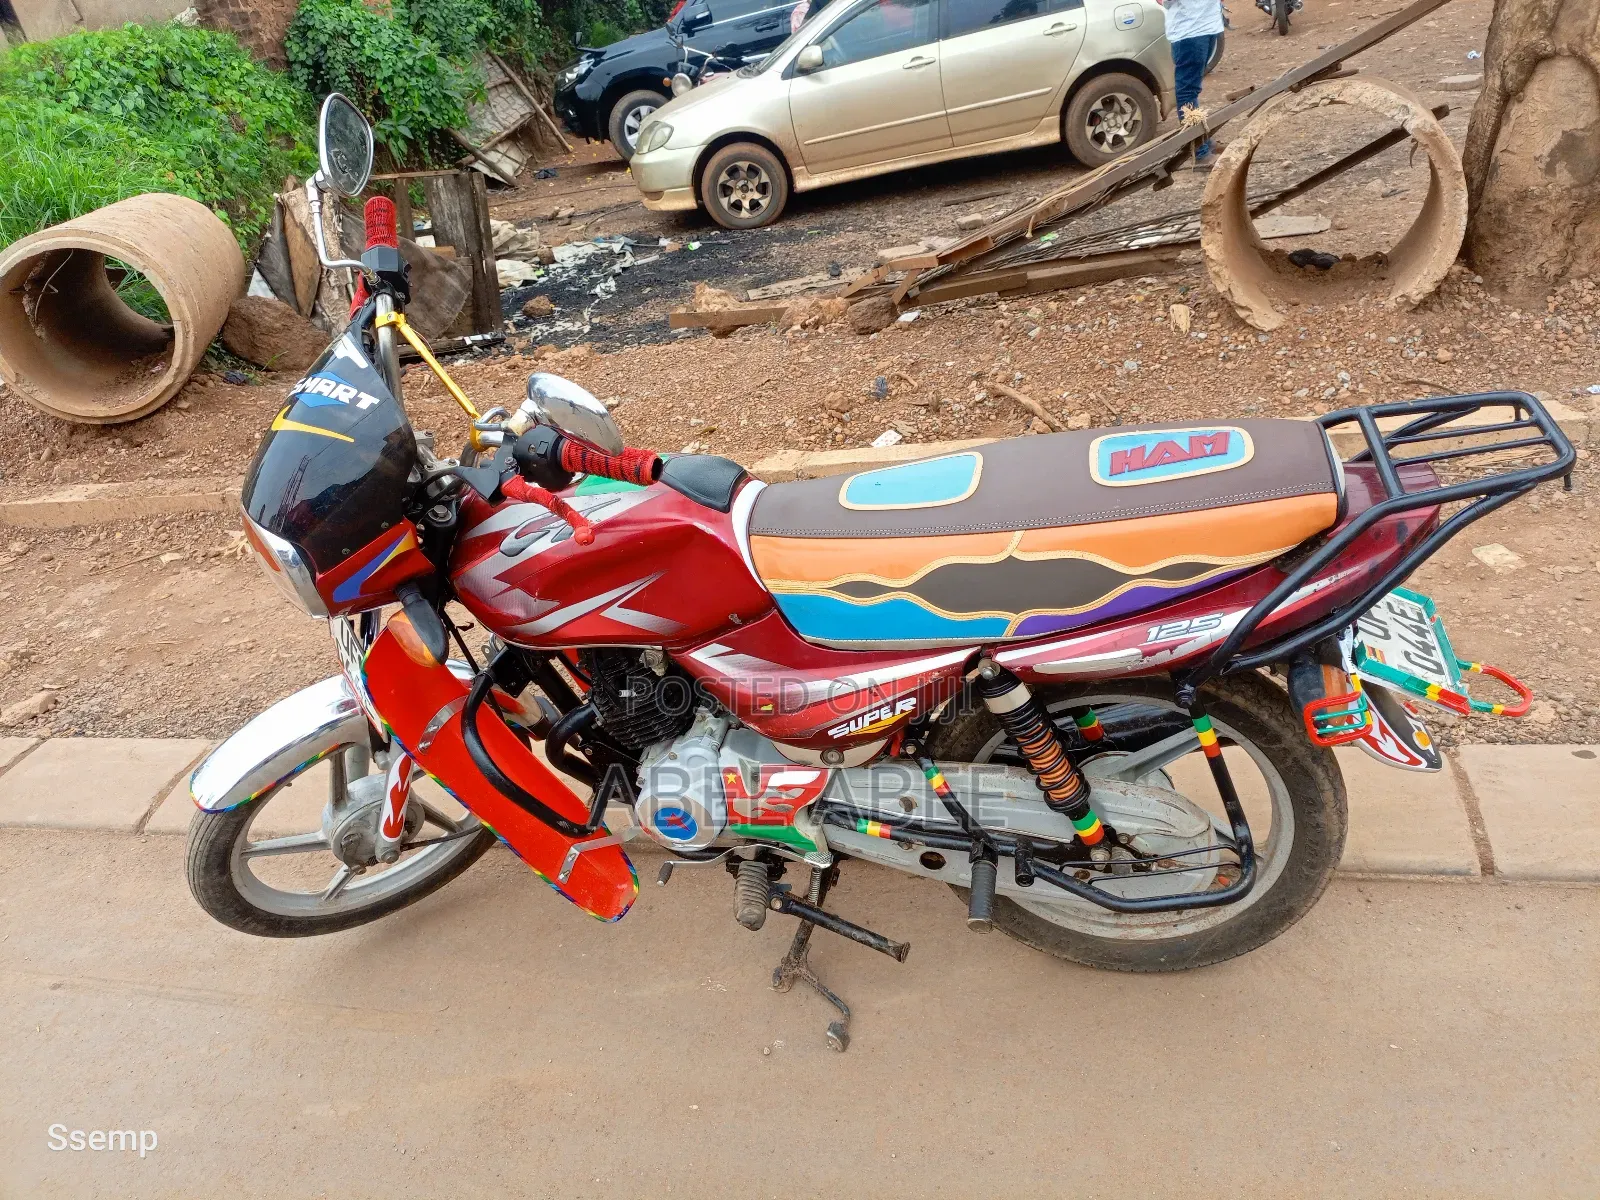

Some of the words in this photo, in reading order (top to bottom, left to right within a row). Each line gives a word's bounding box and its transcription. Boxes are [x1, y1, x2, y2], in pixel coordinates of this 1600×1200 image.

[1108, 431, 1230, 476] HAM
[1146, 612, 1224, 642] 125
[827, 697, 917, 740] SUPER
